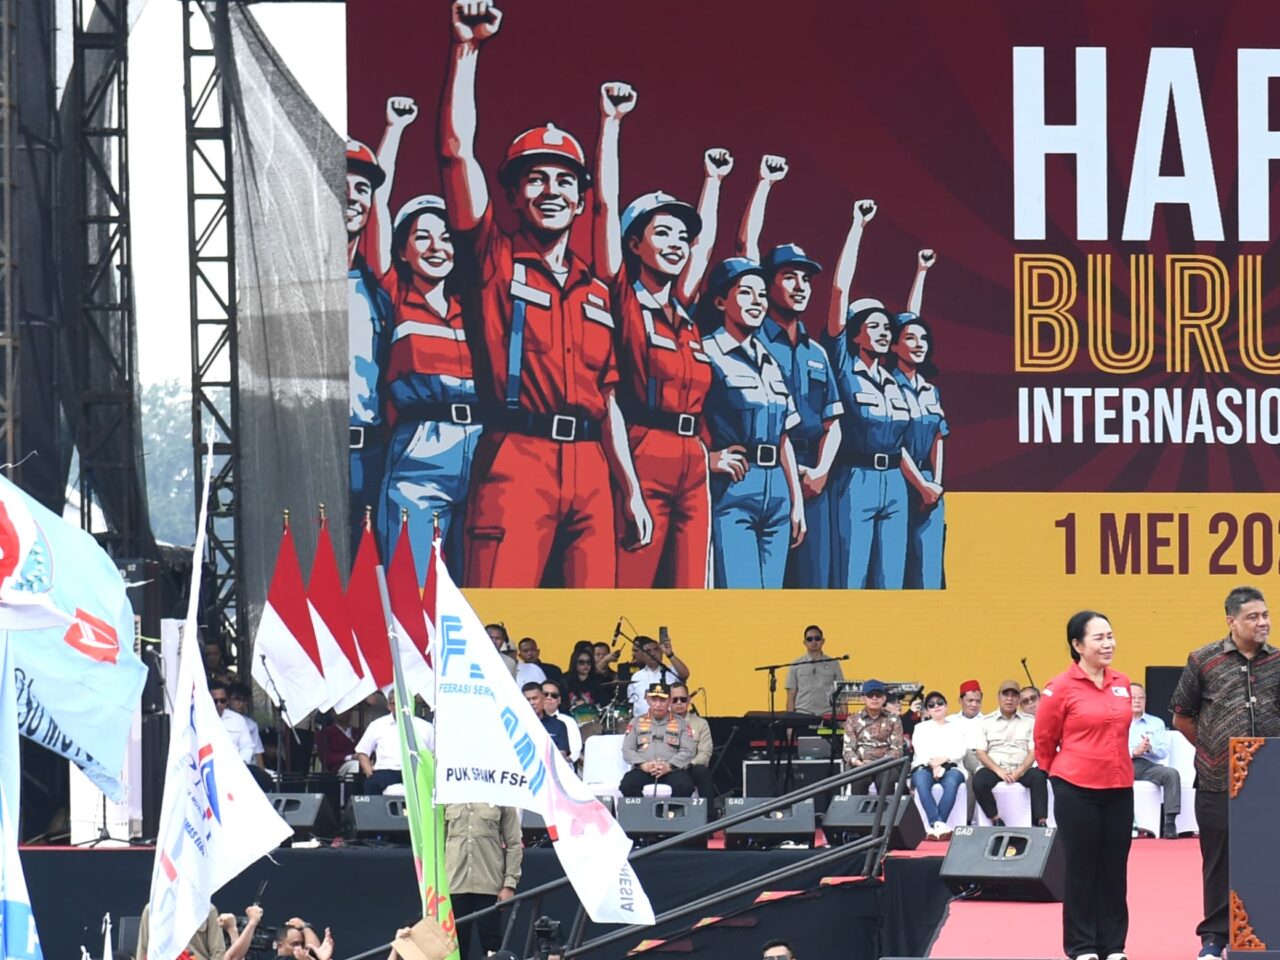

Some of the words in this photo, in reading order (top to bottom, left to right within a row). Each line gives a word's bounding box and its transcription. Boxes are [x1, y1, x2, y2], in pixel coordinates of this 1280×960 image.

[1054, 513, 1076, 575] 1
[1099, 513, 1190, 575] MEI
[446, 767, 468, 782] PUK
